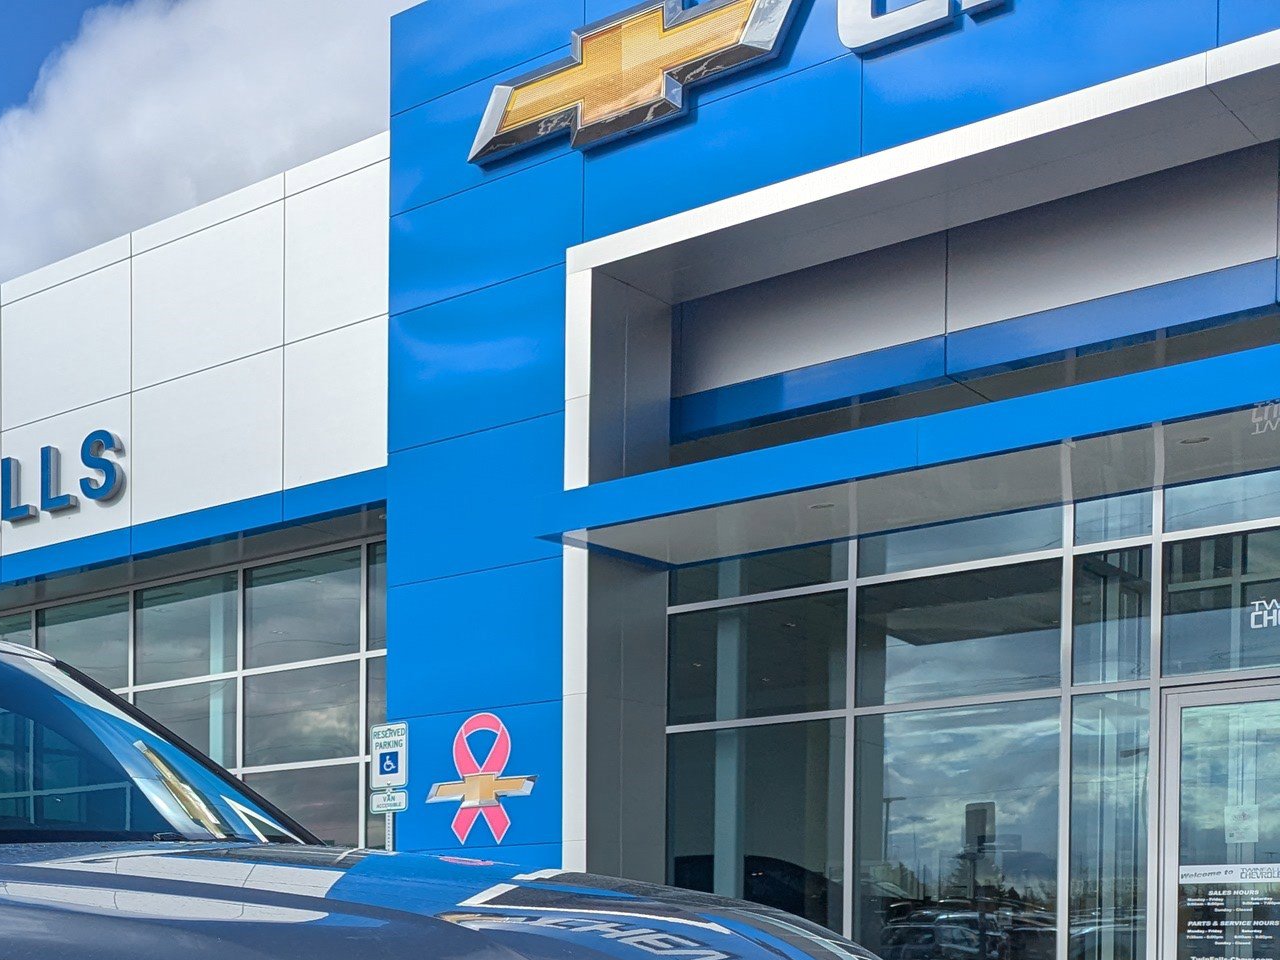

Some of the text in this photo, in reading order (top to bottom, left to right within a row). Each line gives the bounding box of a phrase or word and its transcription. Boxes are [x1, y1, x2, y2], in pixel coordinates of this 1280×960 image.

[373, 727, 405, 740] RESERVED
[375, 739, 403, 750] PARKING
[382, 794, 396, 802] VAN
[1181, 870, 1222, 879] Welcome
